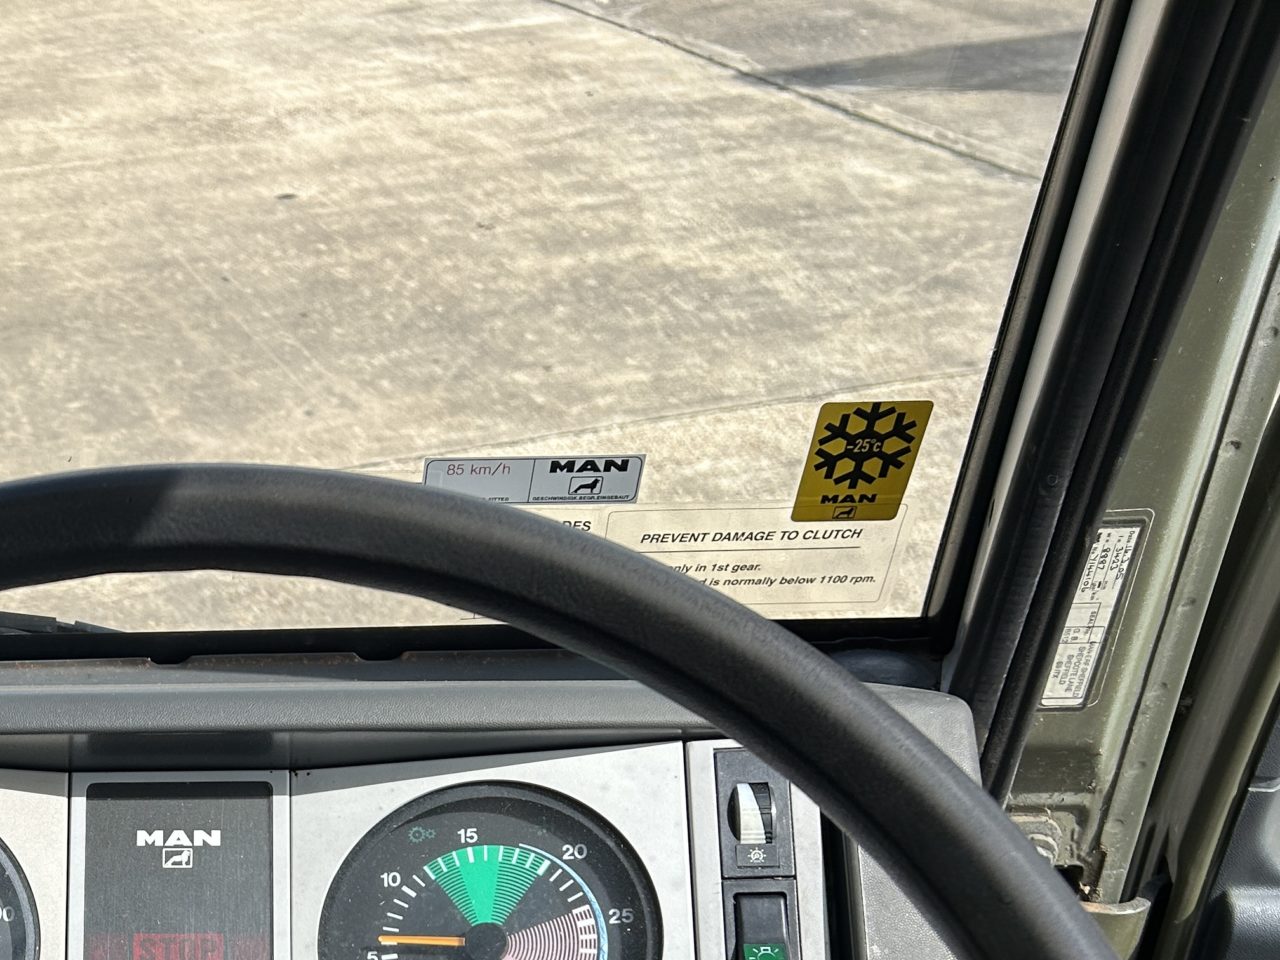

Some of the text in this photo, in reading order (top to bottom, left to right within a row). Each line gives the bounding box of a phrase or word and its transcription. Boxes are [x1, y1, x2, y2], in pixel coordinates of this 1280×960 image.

[446, 462, 511, 476] 85 km/h
[549, 459, 630, 473] MAN
[820, 494, 877, 504] MAN
[640, 528, 864, 544] PREVENT DAMAGE TO CLUTCH
[1110, 547, 1123, 571] 3423
[670, 563, 762, 575] nly in 1st gear.
[709, 578, 720, 586] is
[722, 576, 776, 587] normally
[779, 576, 816, 585] below
[820, 575, 848, 584] 1100
[849, 575, 876, 585] rpm.
[136, 830, 221, 846] MAN
[457, 829, 478, 842] 15
[562, 844, 587, 860] 20
[381, 872, 401, 887] 10
[608, 908, 634, 924] 25
